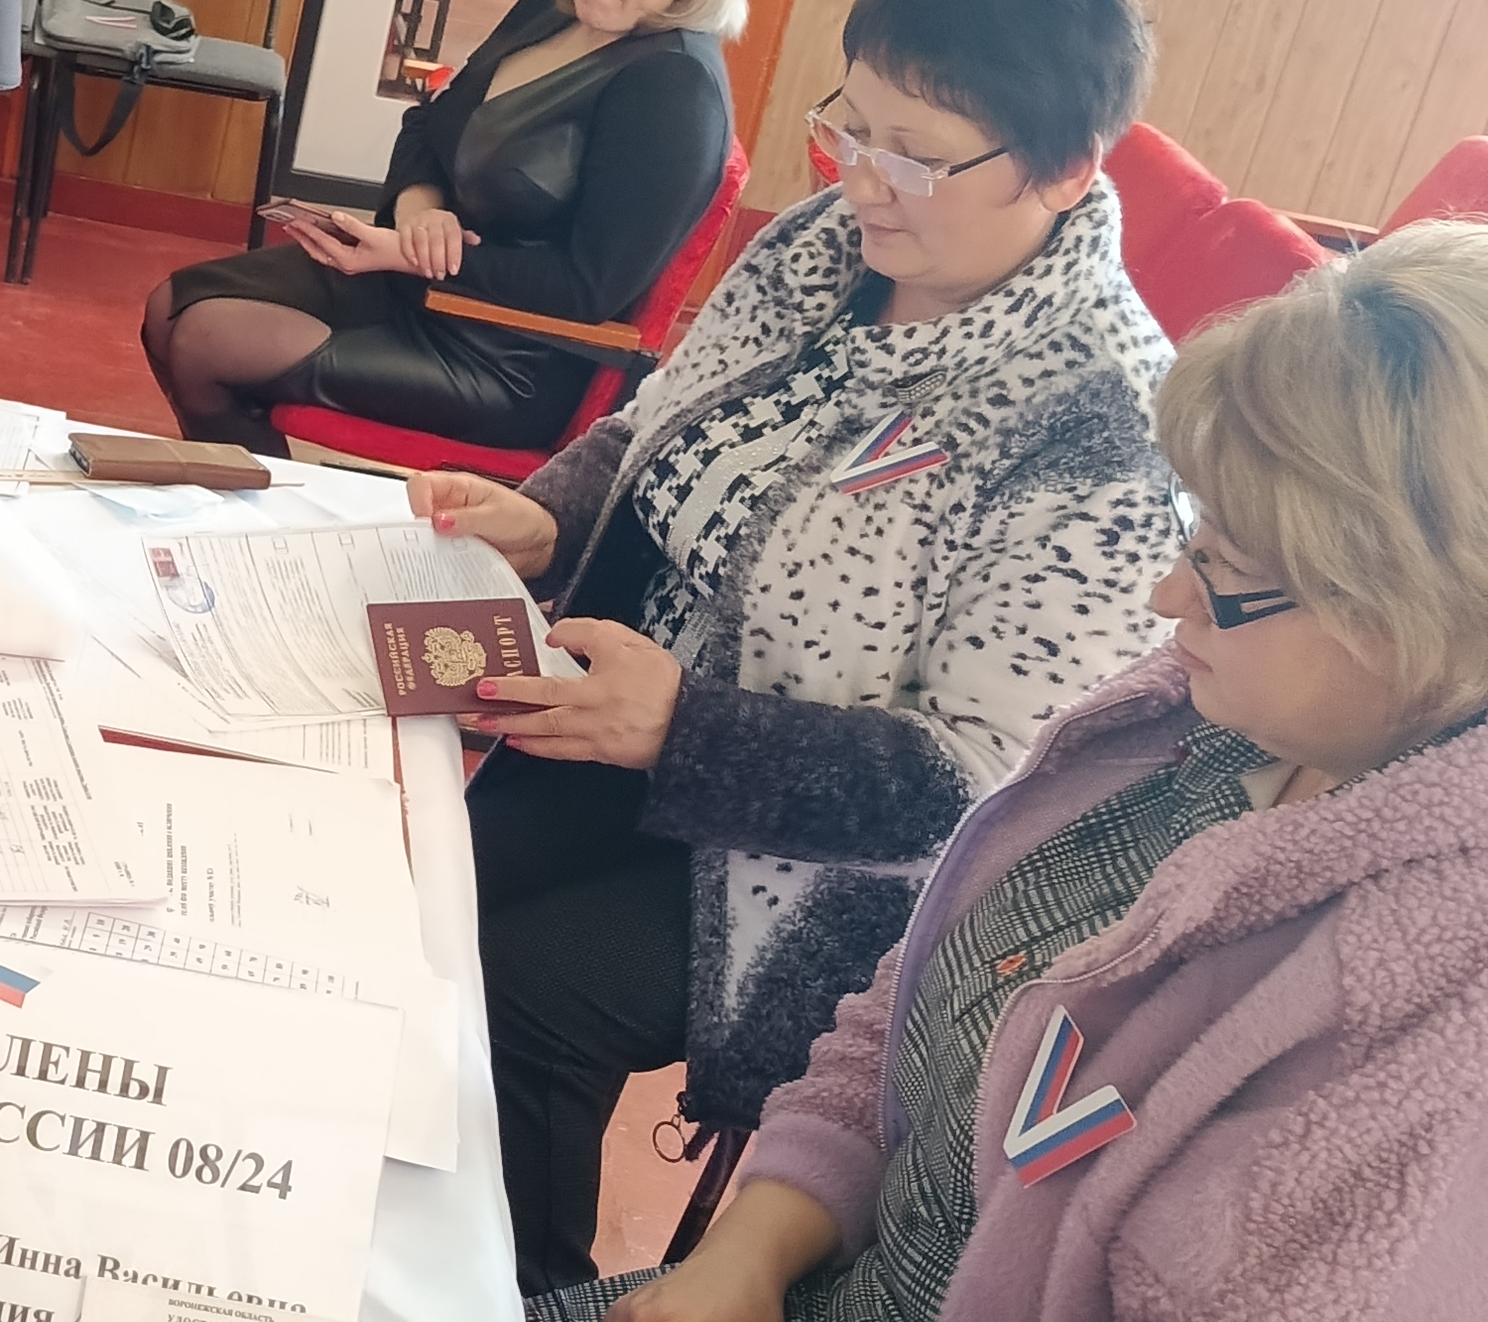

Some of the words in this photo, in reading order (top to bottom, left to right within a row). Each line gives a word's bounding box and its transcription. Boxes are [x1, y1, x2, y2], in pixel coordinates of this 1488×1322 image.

[384, 622, 407, 697] РОССИЙСКАЯ
[396, 626, 417, 691] ФЕДЕРАЦИЯ
[492, 614, 522, 677] АСПОРТ
[166, 1136, 294, 1201] 08/24
[168, 1298, 233, 1317] ВОРОНЕЖСКАЯ
